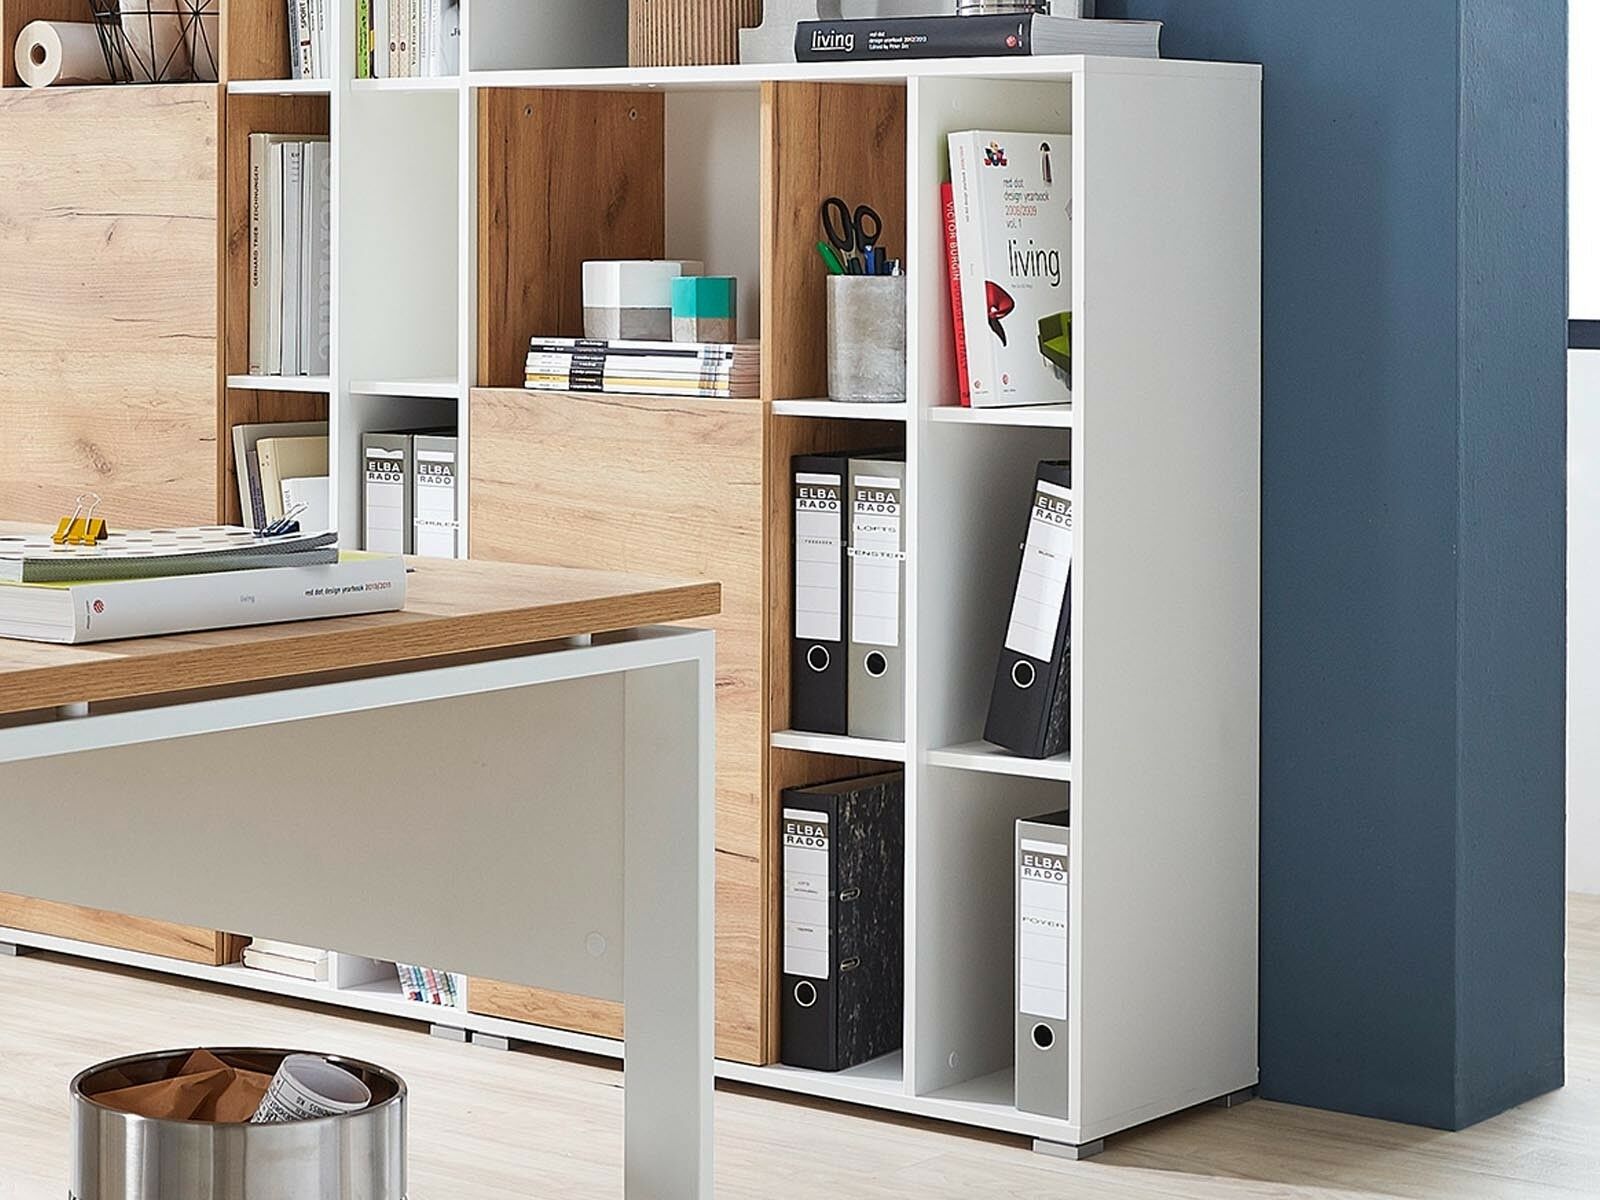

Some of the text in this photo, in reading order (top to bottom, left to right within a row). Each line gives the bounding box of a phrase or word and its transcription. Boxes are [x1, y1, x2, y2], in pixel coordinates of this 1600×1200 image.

[811, 30, 854, 51] living
[946, 201, 957, 240] VICTOR
[949, 241, 960, 281] BURGIN
[1007, 239, 1061, 287] living
[368, 461, 401, 472] ELBA
[420, 464, 451, 476] ELBA
[368, 472, 401, 482] RADO
[420, 475, 452, 485] RADO
[799, 487, 837, 500] ELBA
[857, 490, 896, 503] ELBA
[799, 500, 838, 510] RADO
[857, 503, 896, 514] RADO
[787, 823, 825, 837] ELBA
[786, 835, 825, 847] RADO
[1023, 855, 1064, 870] ELBA
[1024, 868, 1064, 881] RADO
